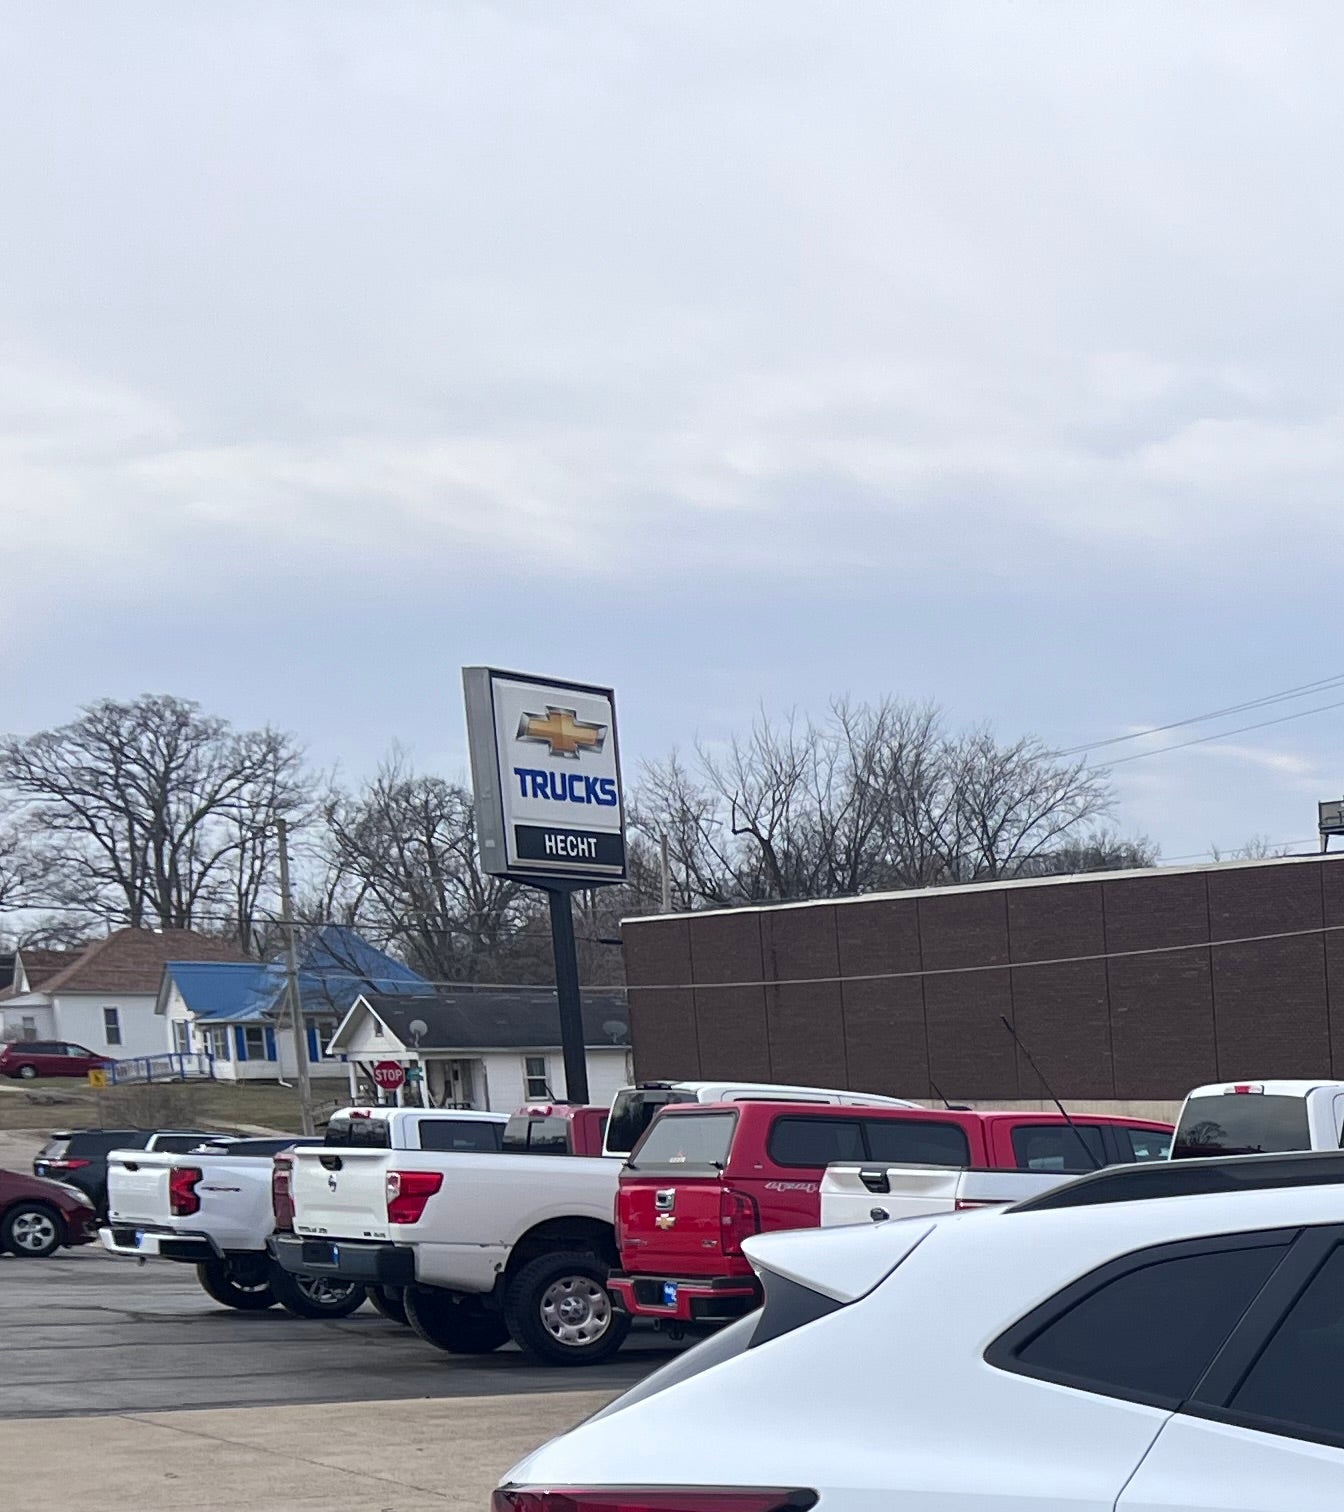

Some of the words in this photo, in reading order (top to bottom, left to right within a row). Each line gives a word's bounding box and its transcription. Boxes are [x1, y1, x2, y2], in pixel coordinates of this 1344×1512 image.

[514, 767, 617, 806] TRUCKS
[545, 834, 597, 857] HECHT
[375, 1069, 402, 1081] STOP
